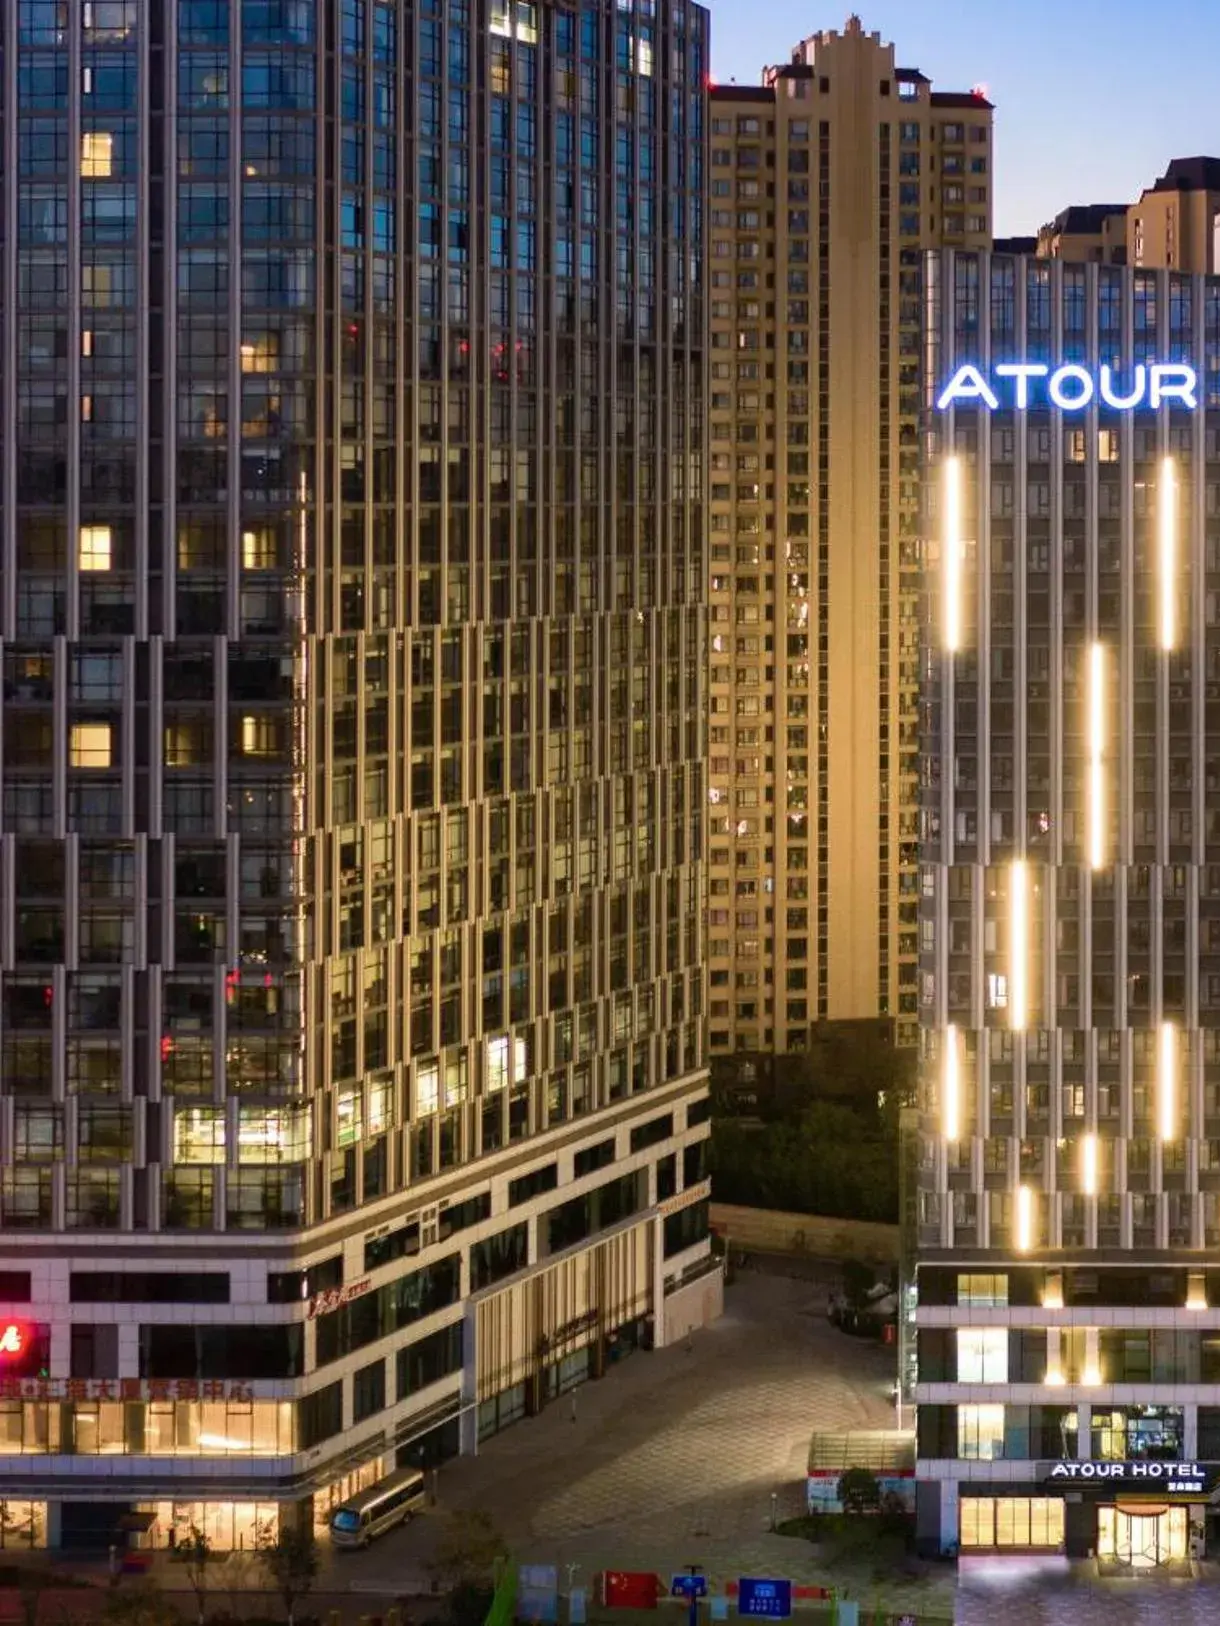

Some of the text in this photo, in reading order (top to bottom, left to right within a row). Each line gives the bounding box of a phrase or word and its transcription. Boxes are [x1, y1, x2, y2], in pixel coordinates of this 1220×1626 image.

[937, 364, 1197, 411] ATOUR
[1051, 1463, 1206, 1477] ATOUR HOTEL
